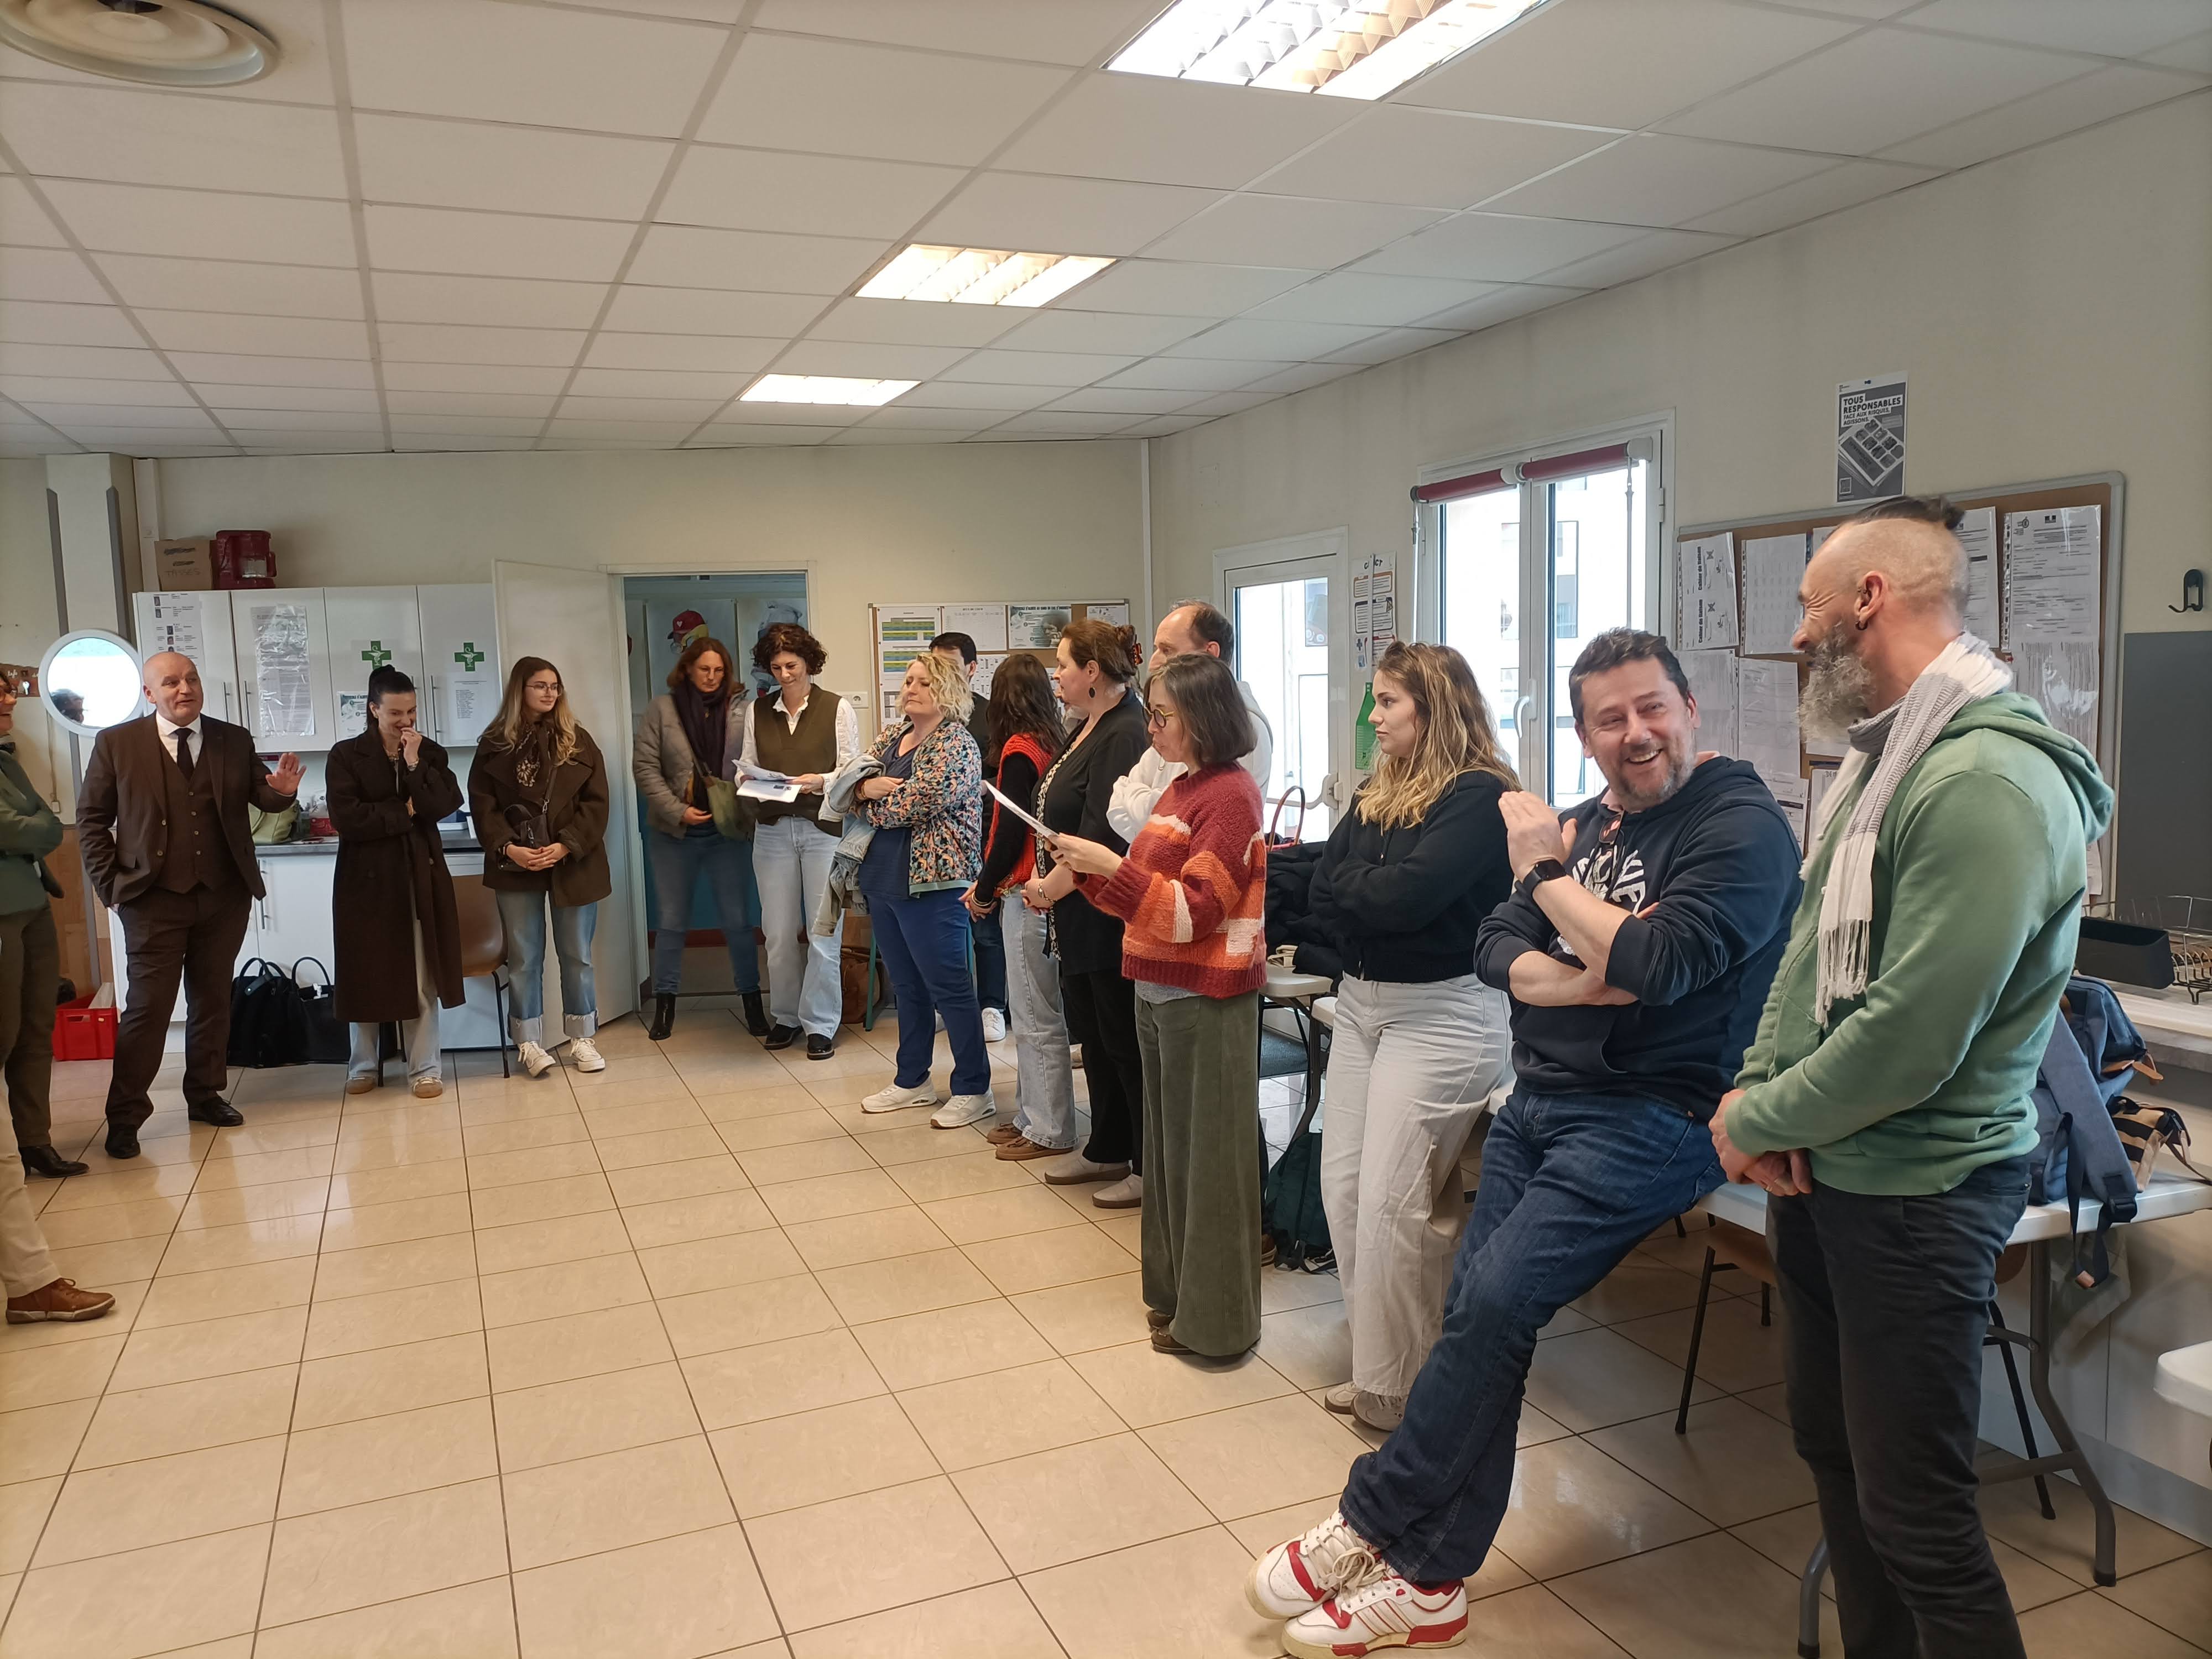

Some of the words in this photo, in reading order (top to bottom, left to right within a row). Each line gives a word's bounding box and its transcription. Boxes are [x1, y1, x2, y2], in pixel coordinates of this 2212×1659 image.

[1843, 396, 1864, 406] TOUS
[1843, 397, 1901, 414] RESPONSABLES
[1868, 408, 1890, 416] RISQUES.
[1843, 417, 1869, 425] AGISSONS.
